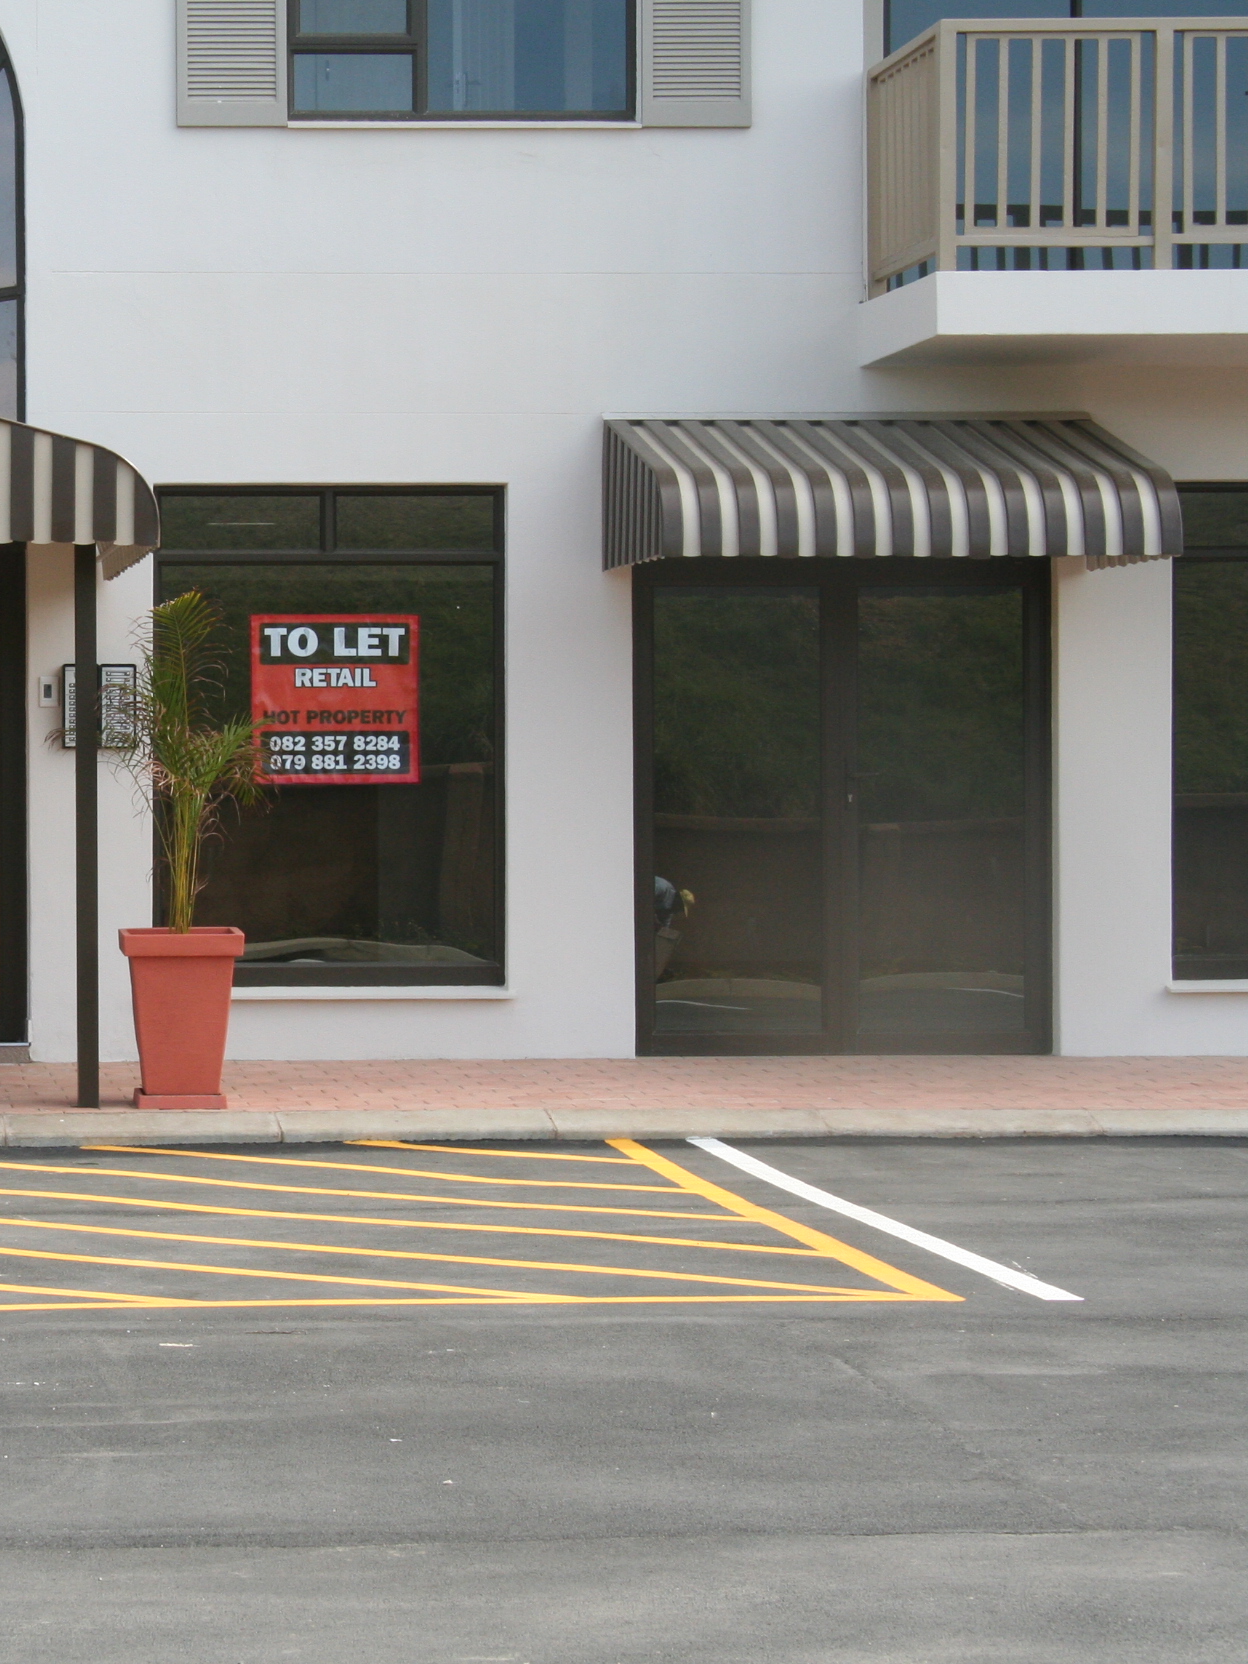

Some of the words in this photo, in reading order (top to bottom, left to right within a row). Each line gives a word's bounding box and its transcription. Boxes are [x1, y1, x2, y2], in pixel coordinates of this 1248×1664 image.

[264, 627, 319, 657] TO
[333, 627, 405, 657] LET
[295, 667, 377, 688] RETAIL
[263, 710, 300, 725] HOT
[306, 710, 407, 724] PROPERTY
[269, 736, 306, 751] 082
[311, 736, 347, 751] 357
[353, 736, 401, 751] 8284
[269, 754, 306, 770] 079
[311, 755, 347, 770] 881
[353, 755, 401, 770] 2398
